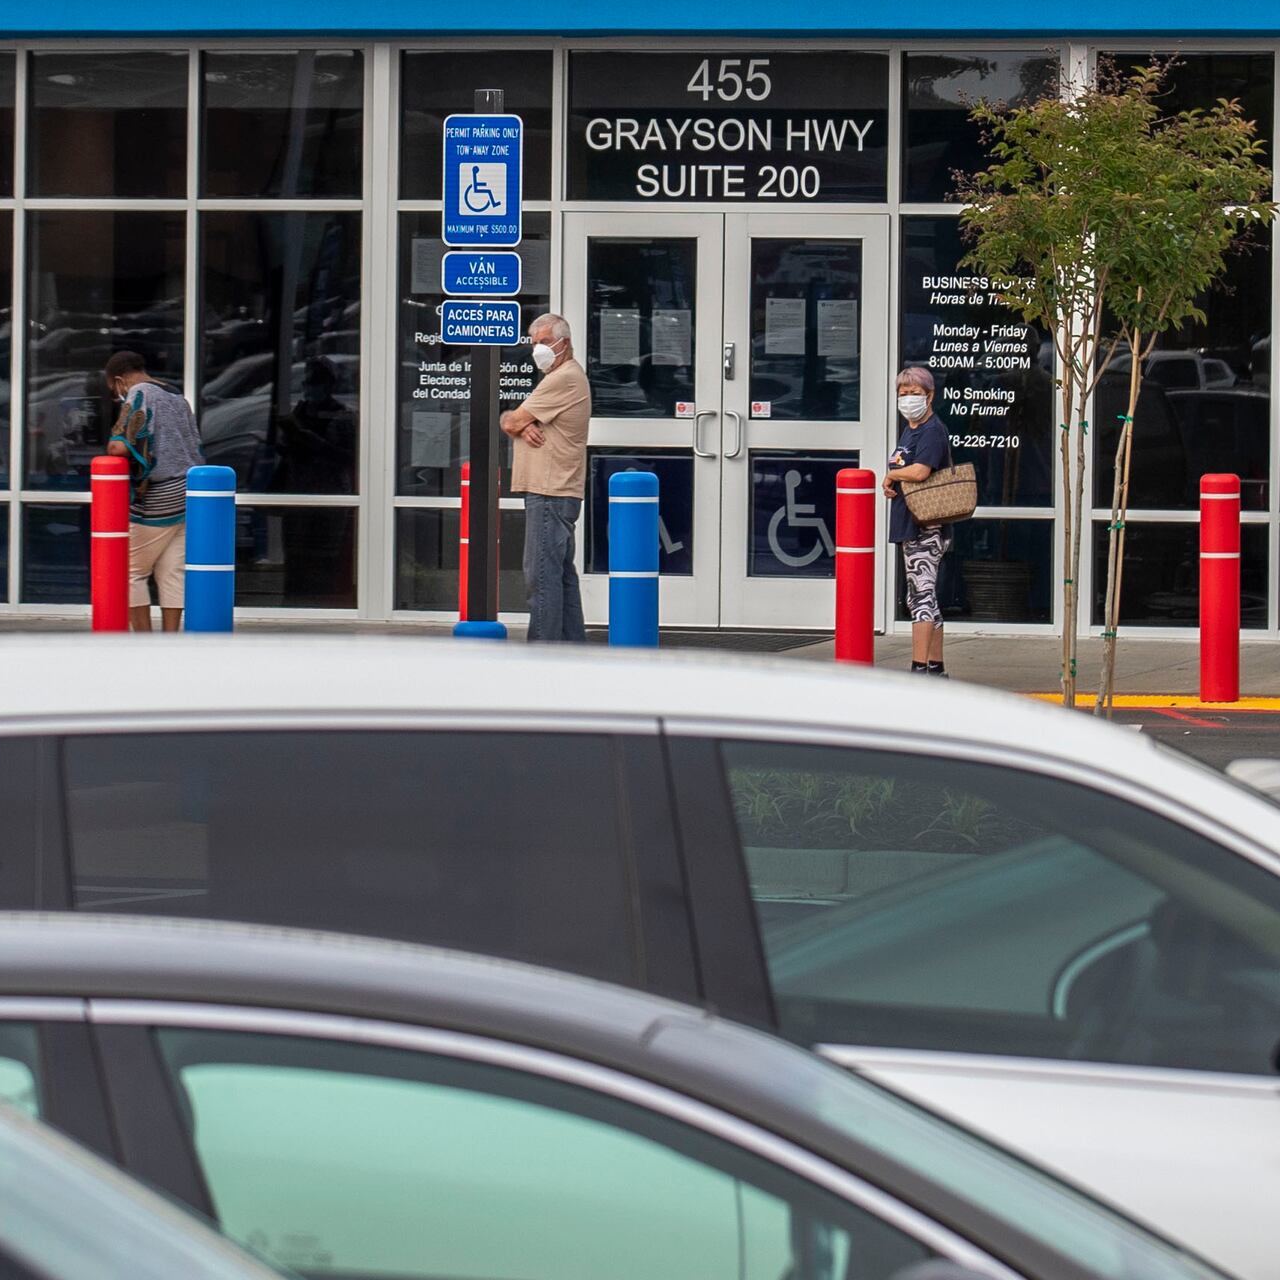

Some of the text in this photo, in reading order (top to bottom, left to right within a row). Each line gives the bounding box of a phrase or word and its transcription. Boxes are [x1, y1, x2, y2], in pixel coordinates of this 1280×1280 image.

[687, 59, 771, 101] 455
[446, 127, 519, 138] PERMIT PARKING ONLY
[585, 118, 874, 152] GRAYSON HWY
[456, 145, 509, 156] TOW-AWAY ZONE
[636, 164, 820, 198] SUITE 200
[447, 224, 474, 234] MAXIMUM
[476, 224, 489, 234] FINE
[469, 262, 495, 274] VAN
[456, 276, 508, 286] ACCESSIBLE
[922, 276, 989, 289] BUSINESS
[930, 292, 965, 304] Horas
[968, 293, 984, 304] de
[447, 309, 484, 321] ACCES
[486, 310, 514, 321] PARA
[447, 324, 515, 337] CAMIONETAS
[933, 324, 980, 339] Monday
[991, 325, 1028, 339] Friday
[933, 340, 1028, 353] Lunes a Viernes
[419, 361, 446, 372] Junta
[448, 361, 462, 372] de
[520, 362, 534, 373] de
[928, 356, 974, 368] 8:00AM
[985, 356, 1031, 369] 5:00PM
[420, 375, 467, 386] Electores
[413, 388, 429, 399] del
[430, 388, 471, 399] Condad
[943, 387, 1015, 402] No Smoking
[950, 403, 1010, 416] No Fumar
[948, 435, 1020, 448] 8-226-7210
